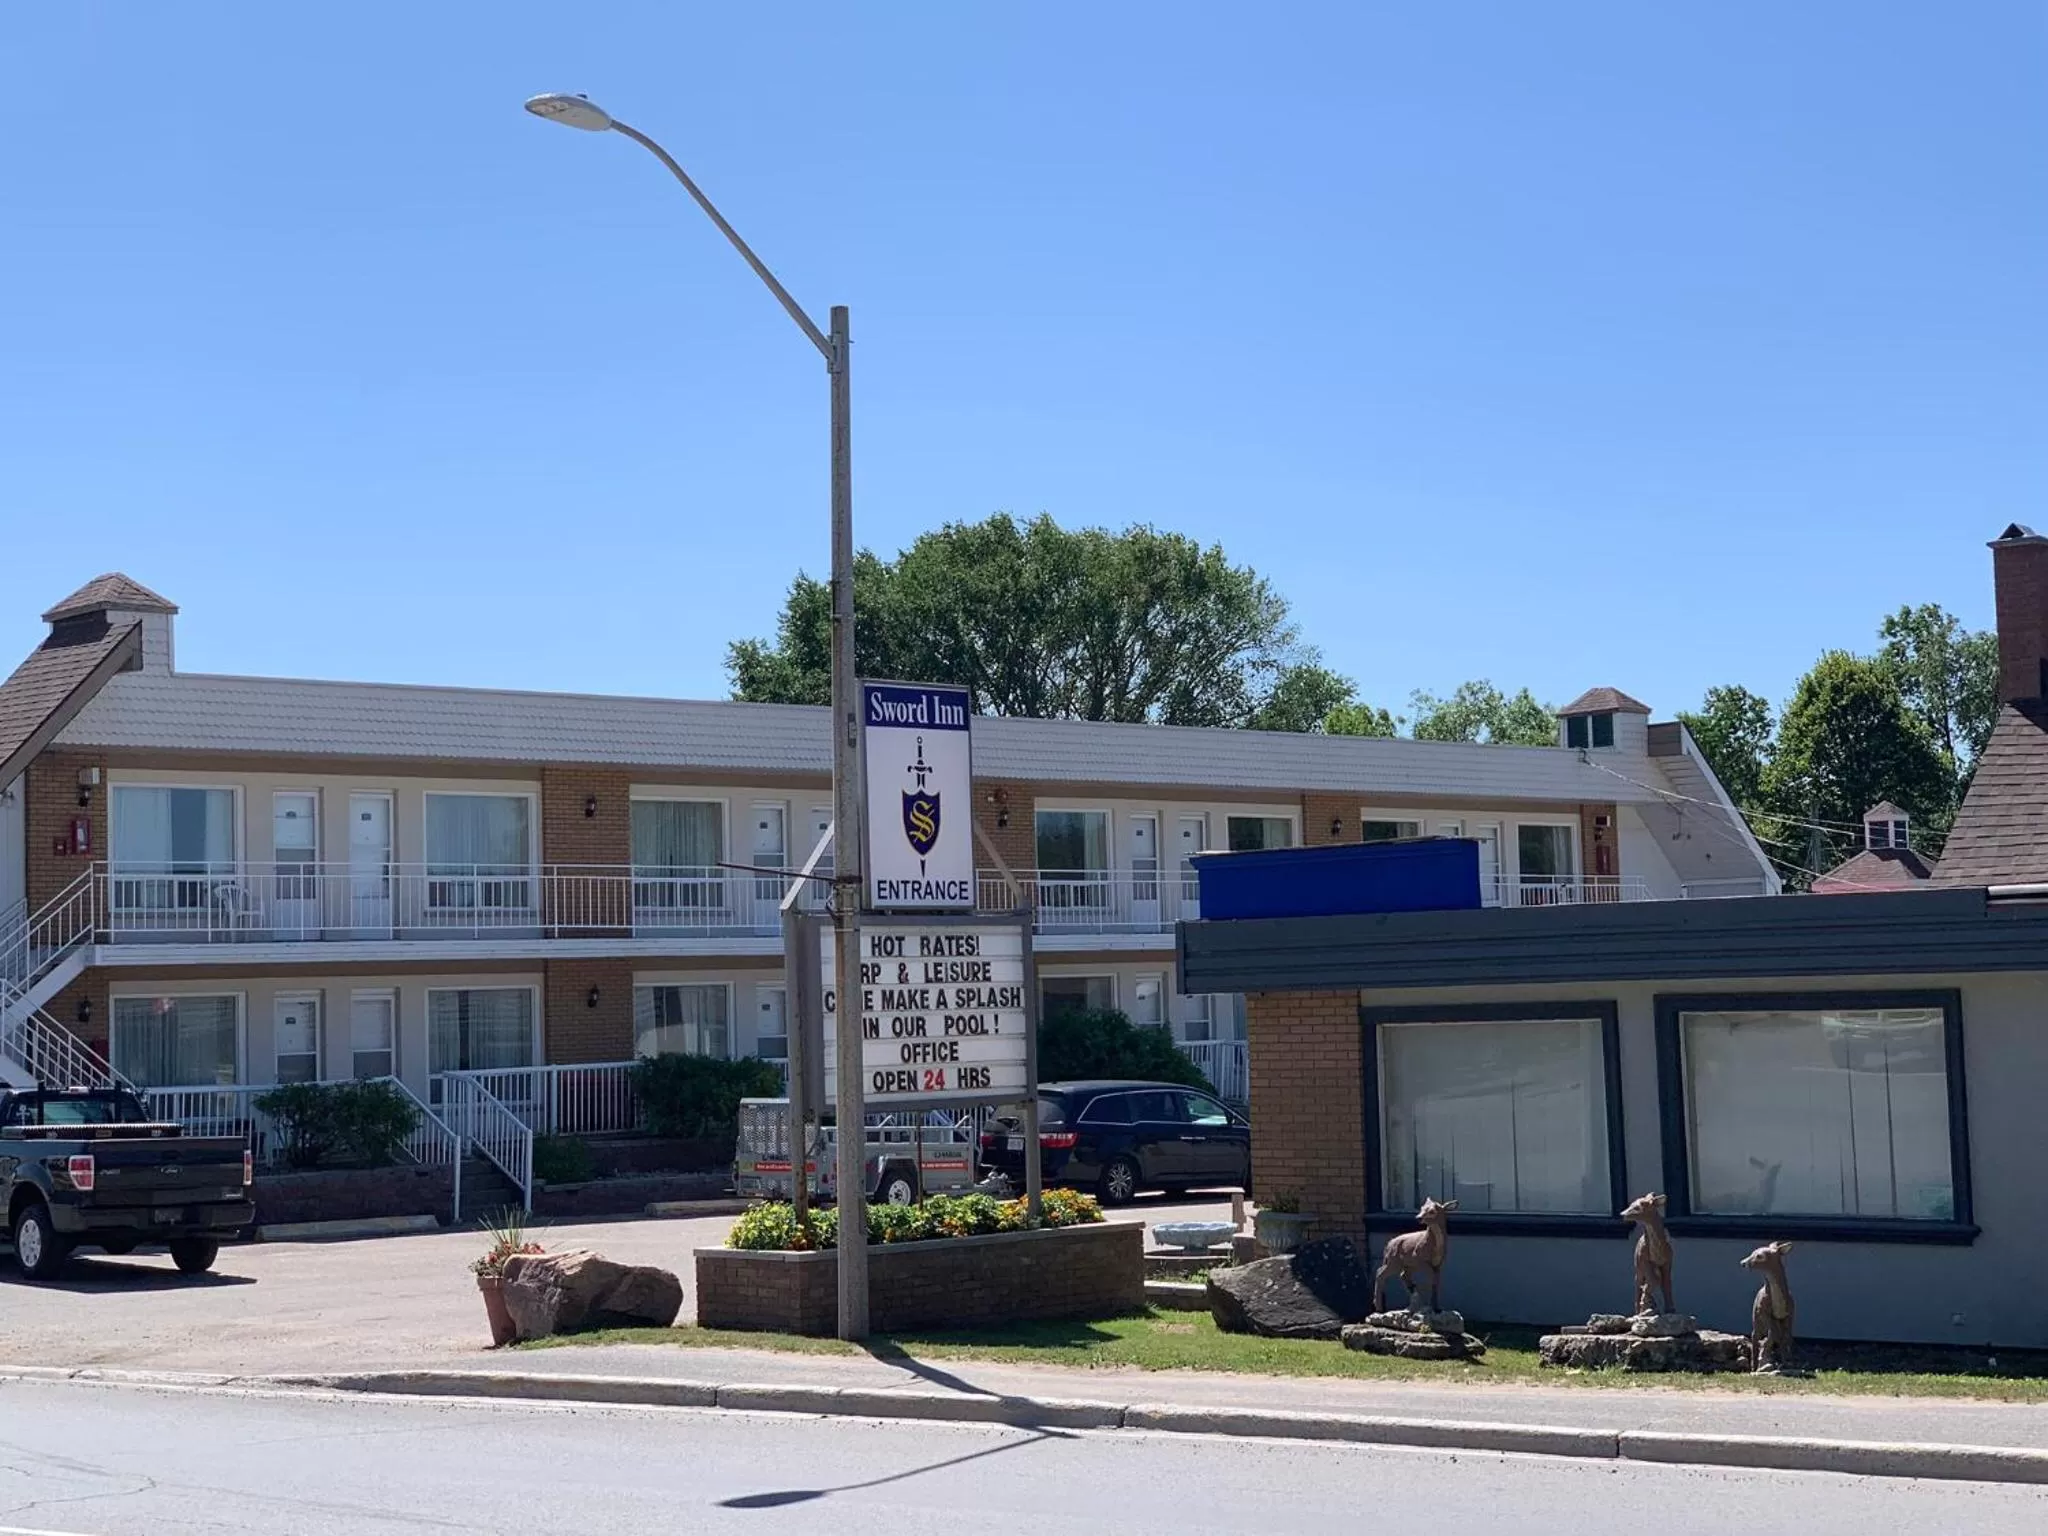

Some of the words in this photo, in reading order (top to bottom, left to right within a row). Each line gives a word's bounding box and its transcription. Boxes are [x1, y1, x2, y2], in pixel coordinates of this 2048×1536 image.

[870, 691, 928, 723] Sword
[934, 695, 965, 726] Inn
[877, 879, 969, 901] ENTRANCE
[870, 935, 906, 957] HOT
[920, 934, 980, 957] RATES!
[860, 962, 882, 985] RP
[898, 961, 910, 985] &
[924, 960, 992, 984] LEISURE
[824, 989, 874, 1013] CE
[881, 988, 930, 1011] MAKE
[936, 987, 948, 1010] A
[955, 986, 1021, 1009] SPLASH
[862, 1016, 880, 1039] IN
[892, 1015, 927, 1038] OUR
[901, 1040, 960, 1064] OFFICE
[873, 1070, 919, 1093] OPEN
[924, 1068, 946, 1092] 24
[957, 1066, 991, 1089] HRS
